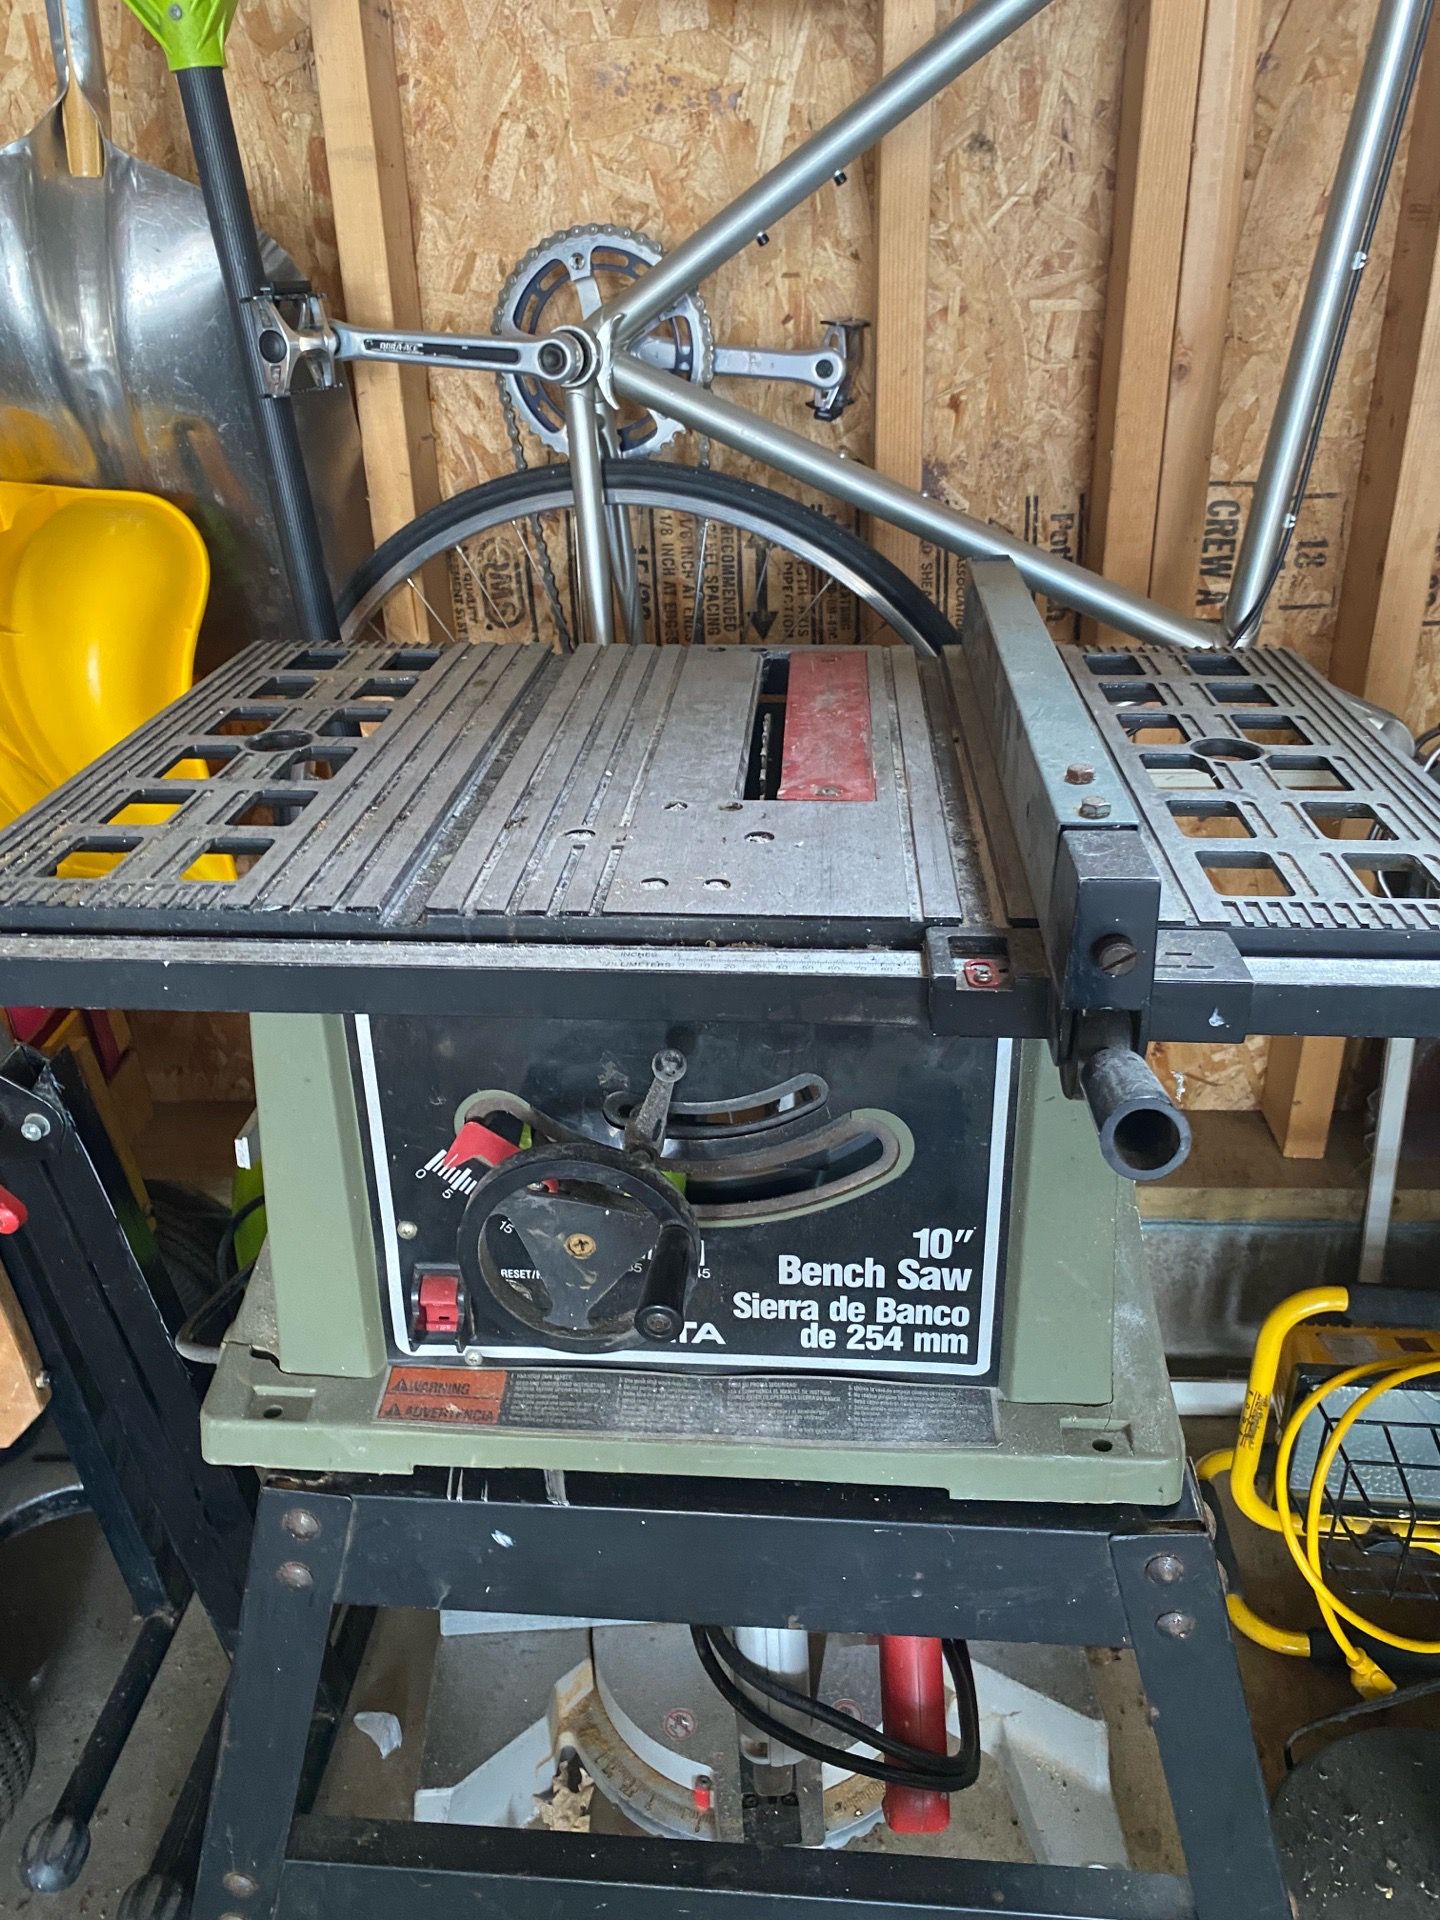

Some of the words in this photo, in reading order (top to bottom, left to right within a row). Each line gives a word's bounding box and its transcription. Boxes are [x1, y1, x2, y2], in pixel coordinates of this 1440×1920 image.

[660, 515, 674, 536] 1/8
[1199, 500, 1240, 579] CREW
[661, 543, 676, 577] INCH
[663, 581, 678, 597] AT
[720, 527, 738, 633] RECOMMENDED
[704, 576, 722, 637] SPACING
[1196, 589, 1227, 607] A
[415, 1168, 427, 1179] 0
[441, 1188, 454, 1199] 5
[499, 1220, 515, 1234] 15
[778, 1254, 886, 1289] Bench
[897, 1258, 973, 1292] Saw
[732, 1291, 819, 1321] Sierra
[829, 1295, 866, 1323] de
[876, 1296, 971, 1327] Banco
[800, 1322, 837, 1350] de
[846, 1324, 904, 1351] 254
[913, 1331, 969, 1355] mm
[407, 1380, 471, 1395] WARNING
